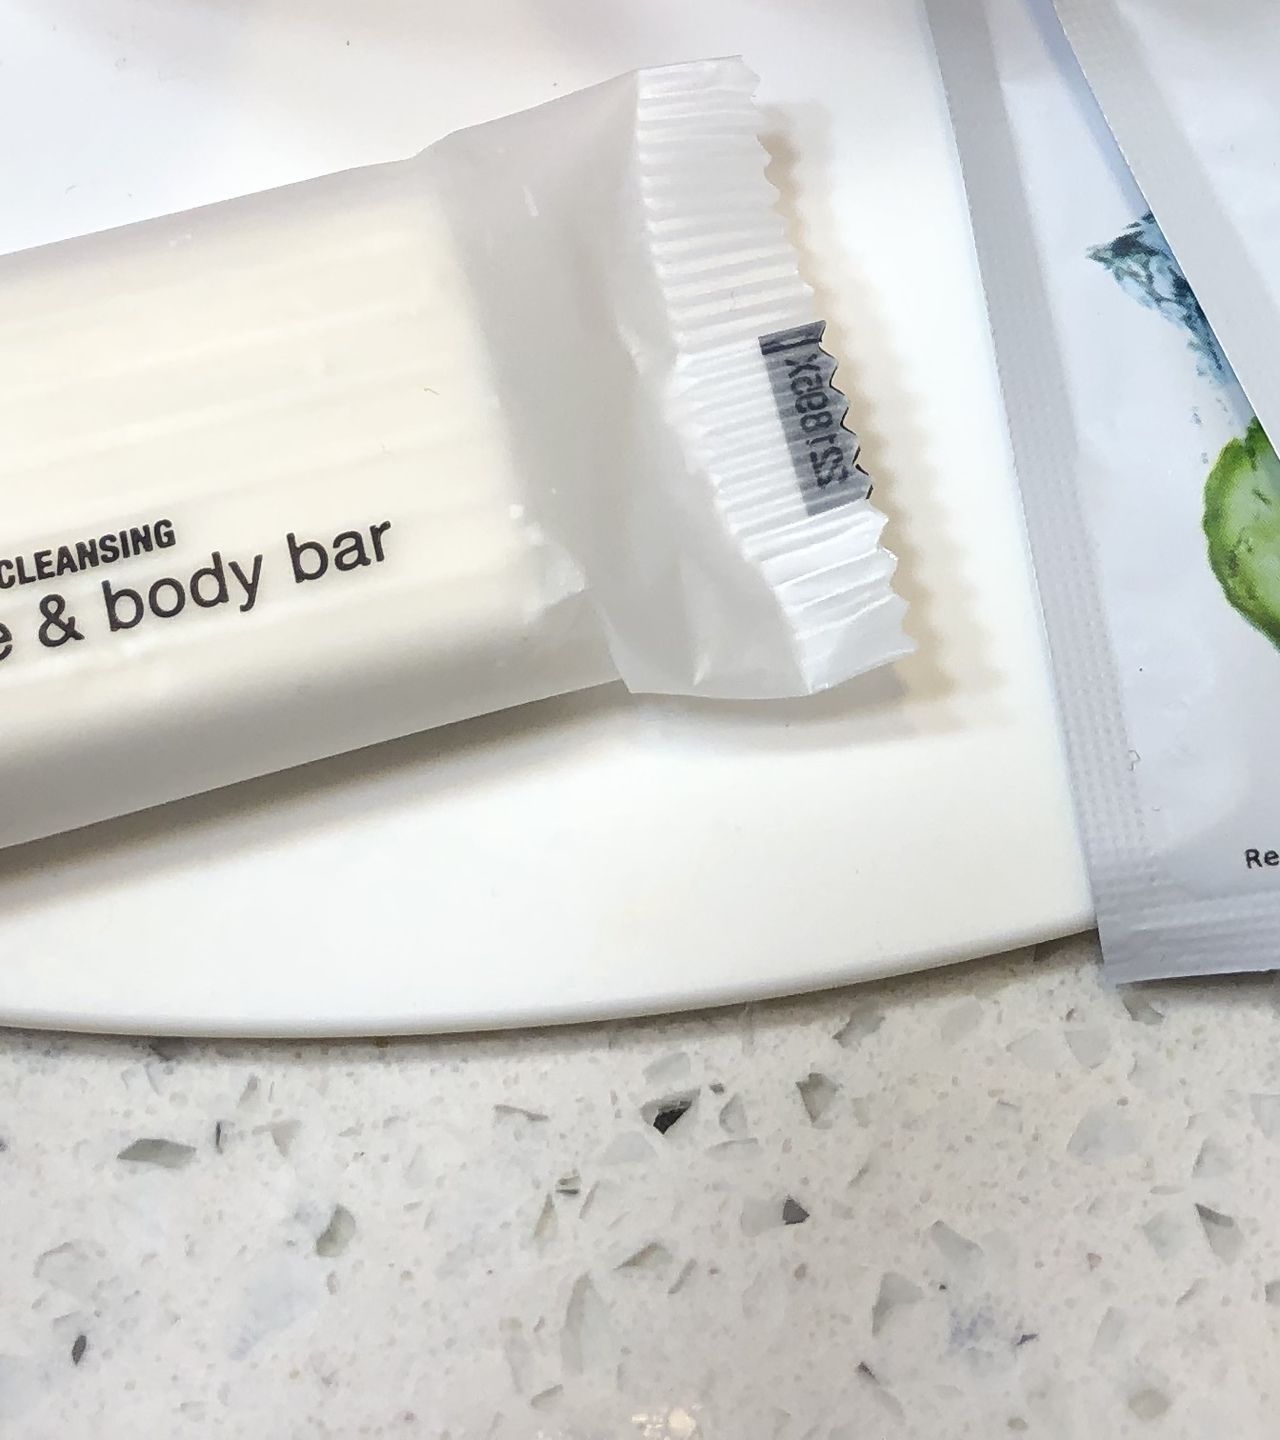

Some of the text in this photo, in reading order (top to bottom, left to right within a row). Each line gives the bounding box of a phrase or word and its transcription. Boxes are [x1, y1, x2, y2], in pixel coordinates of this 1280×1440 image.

[37, 593, 85, 648] &
[102, 551, 263, 632] body
[286, 521, 391, 583] bar
